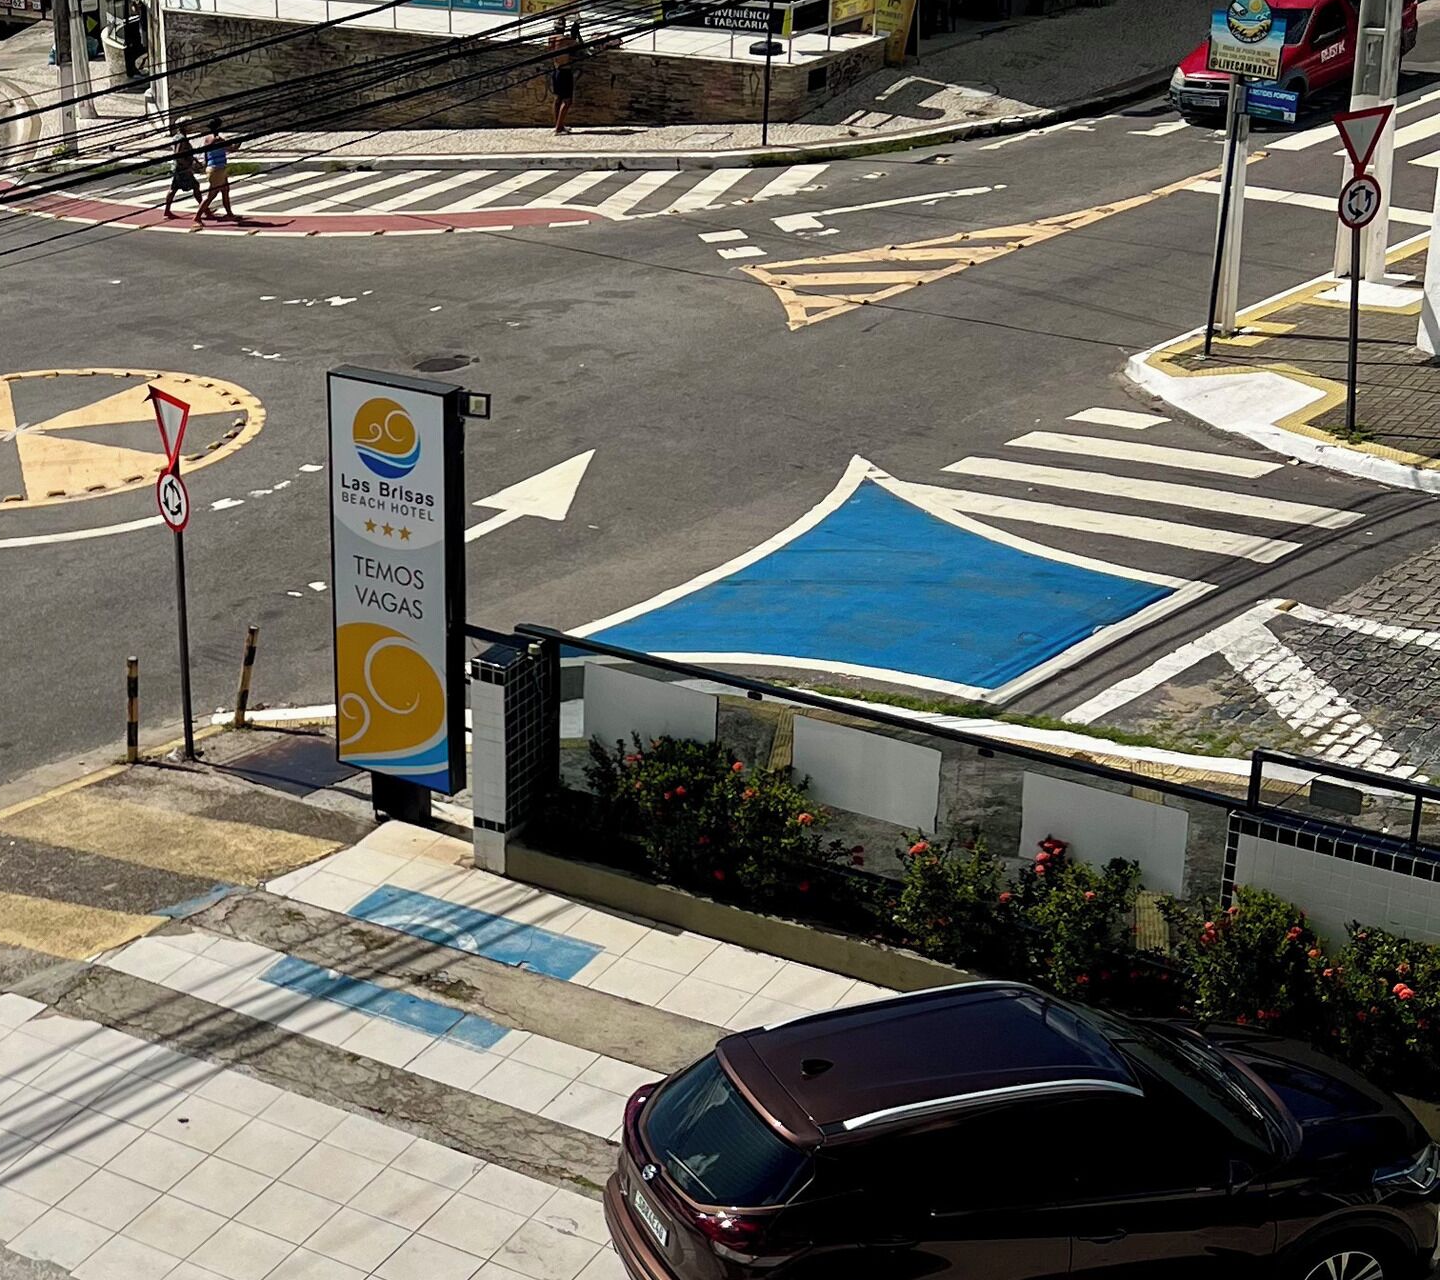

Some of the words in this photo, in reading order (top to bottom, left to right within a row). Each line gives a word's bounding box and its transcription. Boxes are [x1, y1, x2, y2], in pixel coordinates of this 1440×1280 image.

[341, 473, 370, 494] Las
[379, 481, 435, 507] Brisas
[341, 491, 386, 511] BEACH
[390, 502, 434, 521] HOTEL
[353, 555, 425, 590] TEMOS
[355, 585, 424, 620] VAGAS
